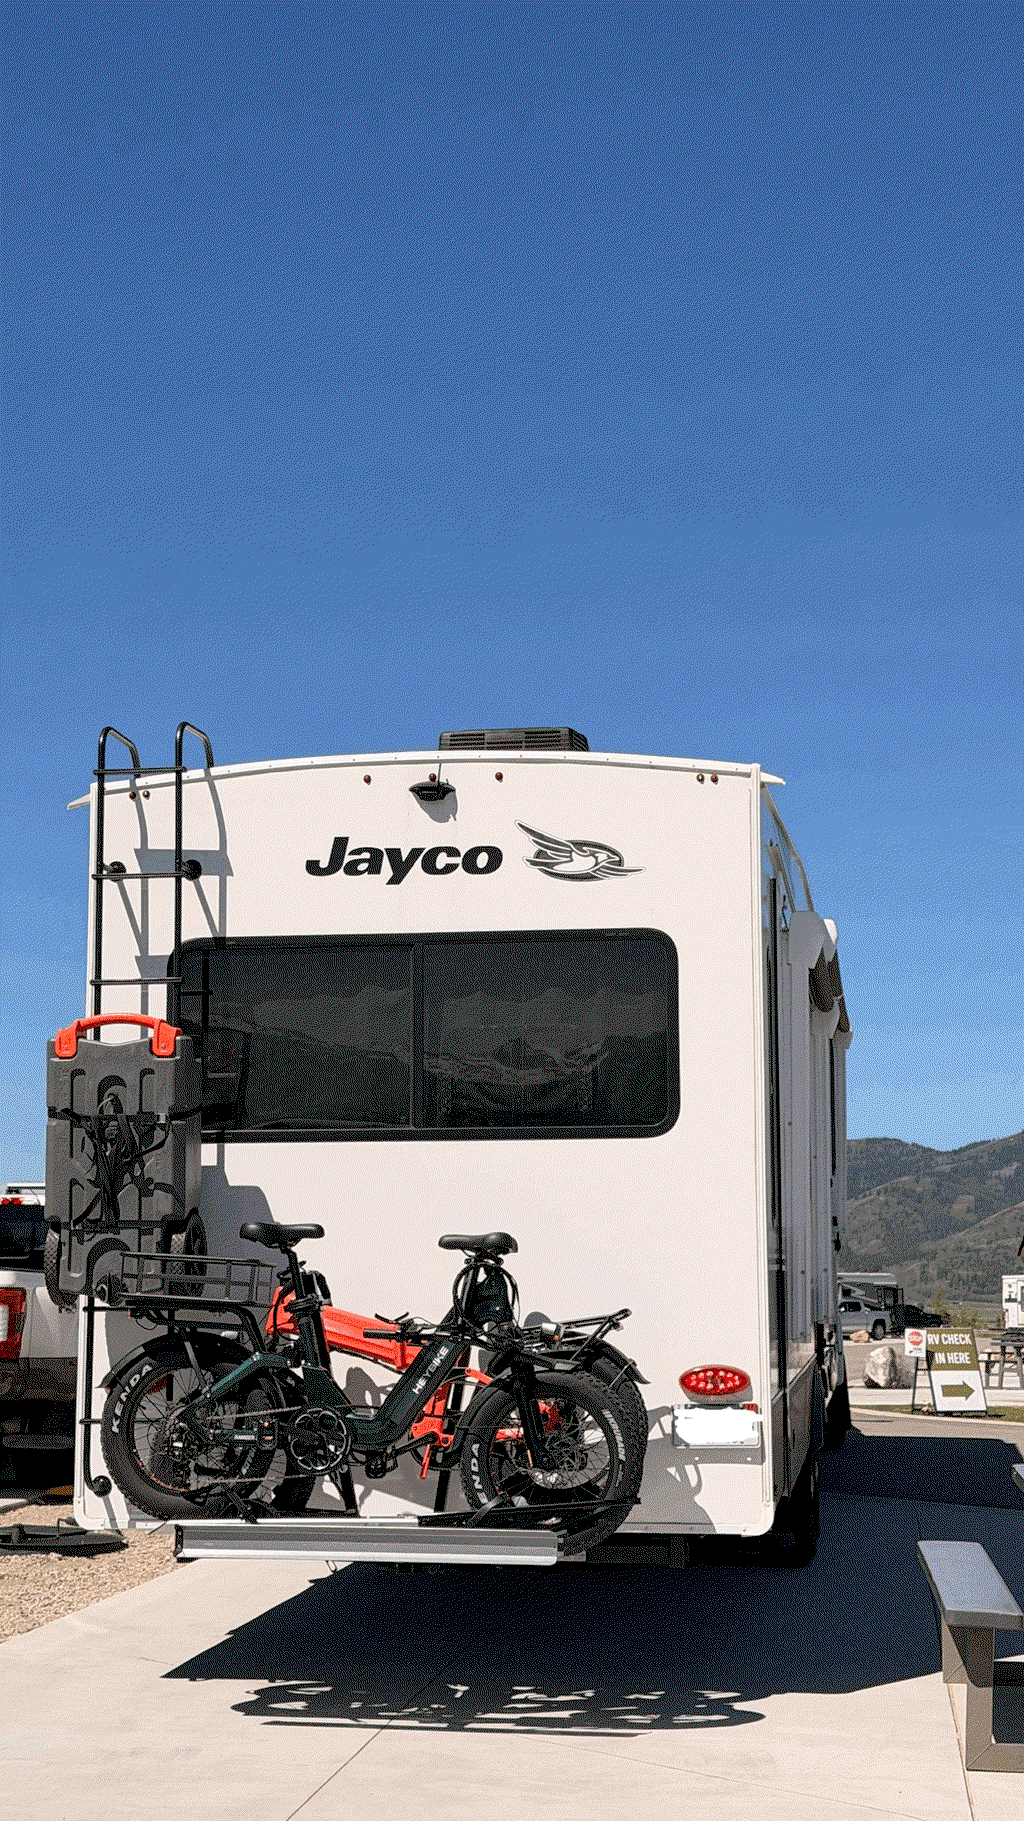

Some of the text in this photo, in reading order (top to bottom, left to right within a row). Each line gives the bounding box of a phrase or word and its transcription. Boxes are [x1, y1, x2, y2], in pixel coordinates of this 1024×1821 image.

[305, 836, 503, 885] Jayco
[927, 1333, 940, 1345] RV
[941, 1333, 972, 1345] CHECK
[934, 1352, 971, 1364] IN HERE
[412, 1345, 449, 1394] HEYBIKE
[111, 1364, 152, 1434] KENDA
[470, 1442, 489, 1504] ENDA
